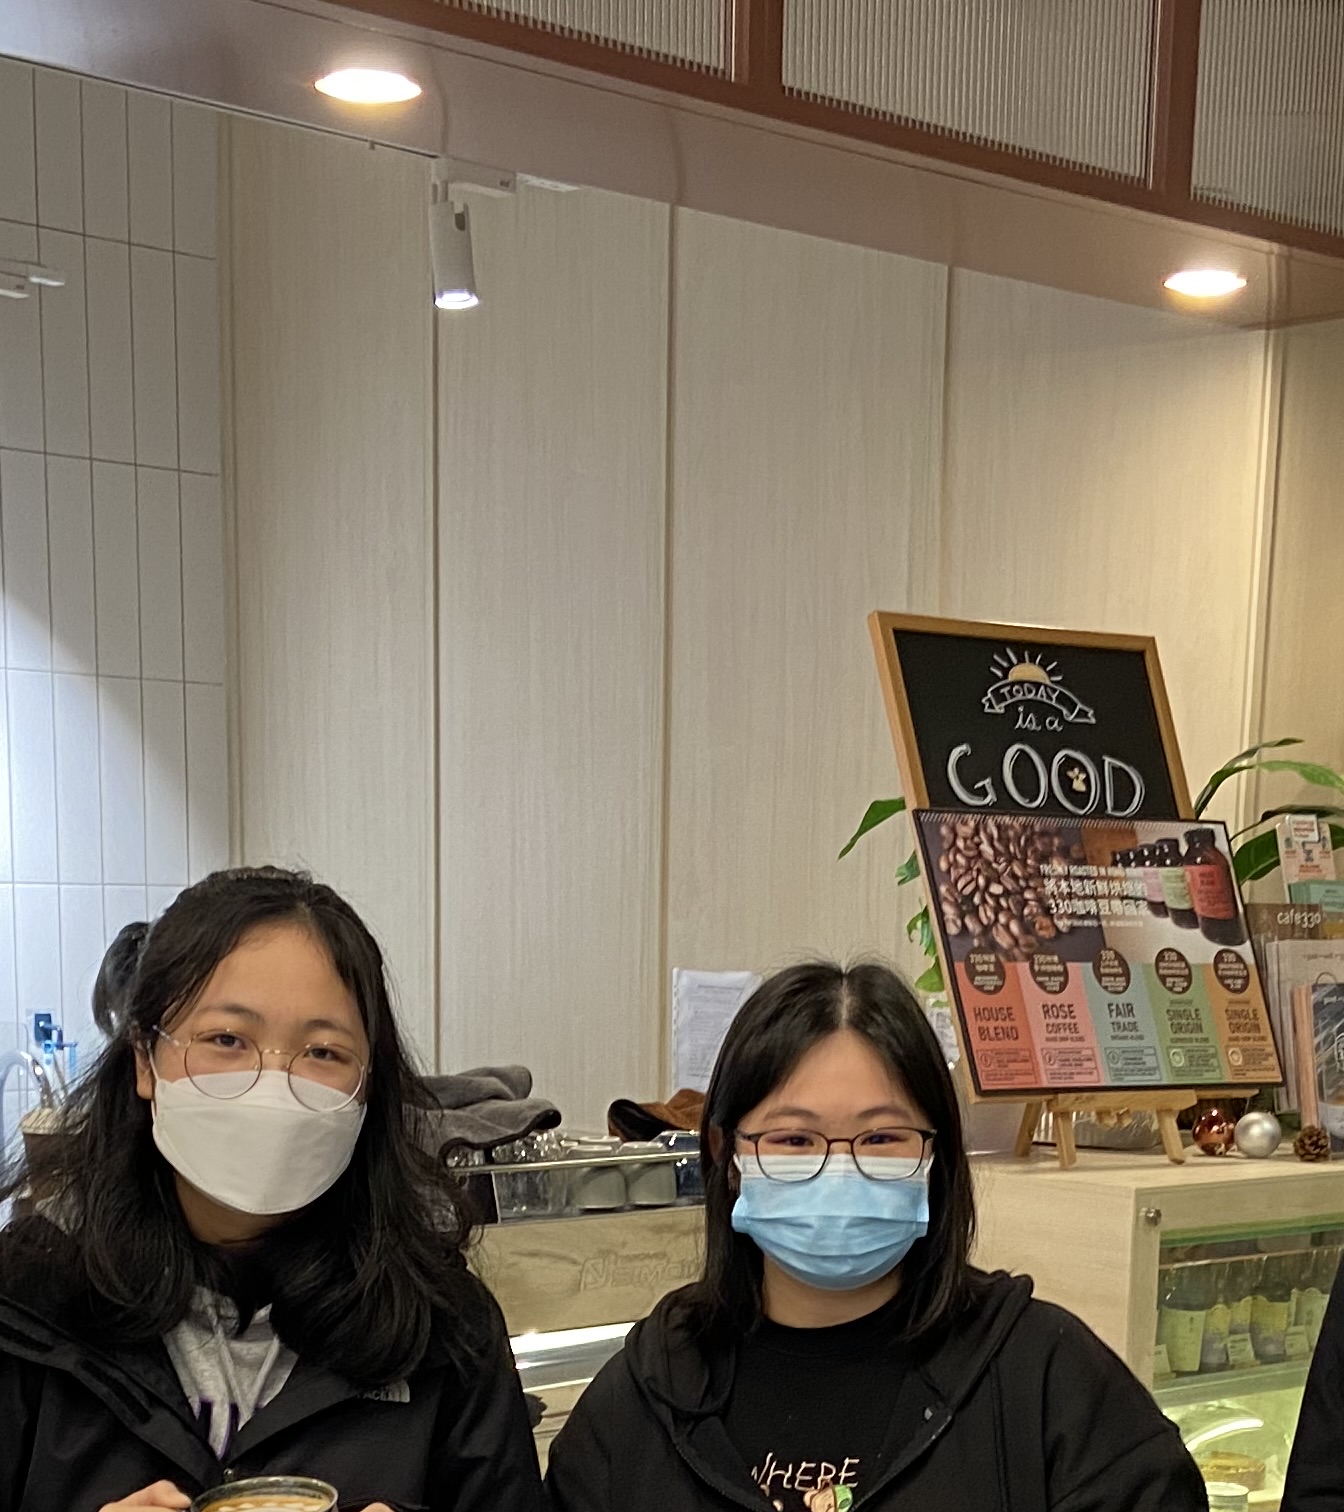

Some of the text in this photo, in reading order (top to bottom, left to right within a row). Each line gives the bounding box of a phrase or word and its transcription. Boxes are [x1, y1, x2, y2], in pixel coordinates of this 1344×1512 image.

[999, 683, 1060, 706] TODAY
[1015, 705, 1064, 732] is a
[946, 741, 1146, 817] GOOD
[1276, 908, 1322, 928] cafe330
[973, 1006, 1016, 1022] HOUSE
[1042, 1003, 1077, 1020] ROSE
[1107, 1002, 1136, 1019] FAIR
[1166, 1008, 1202, 1022] SINGLE
[1224, 1008, 1260, 1022] SINGLE
[978, 1025, 1019, 1042] BLEND
[1045, 1022, 1080, 1035] COFFEE
[1110, 1020, 1140, 1033] TRADE
[1170, 1021, 1203, 1035] ORIGIN
[1228, 1021, 1261, 1035] ORIGIN
